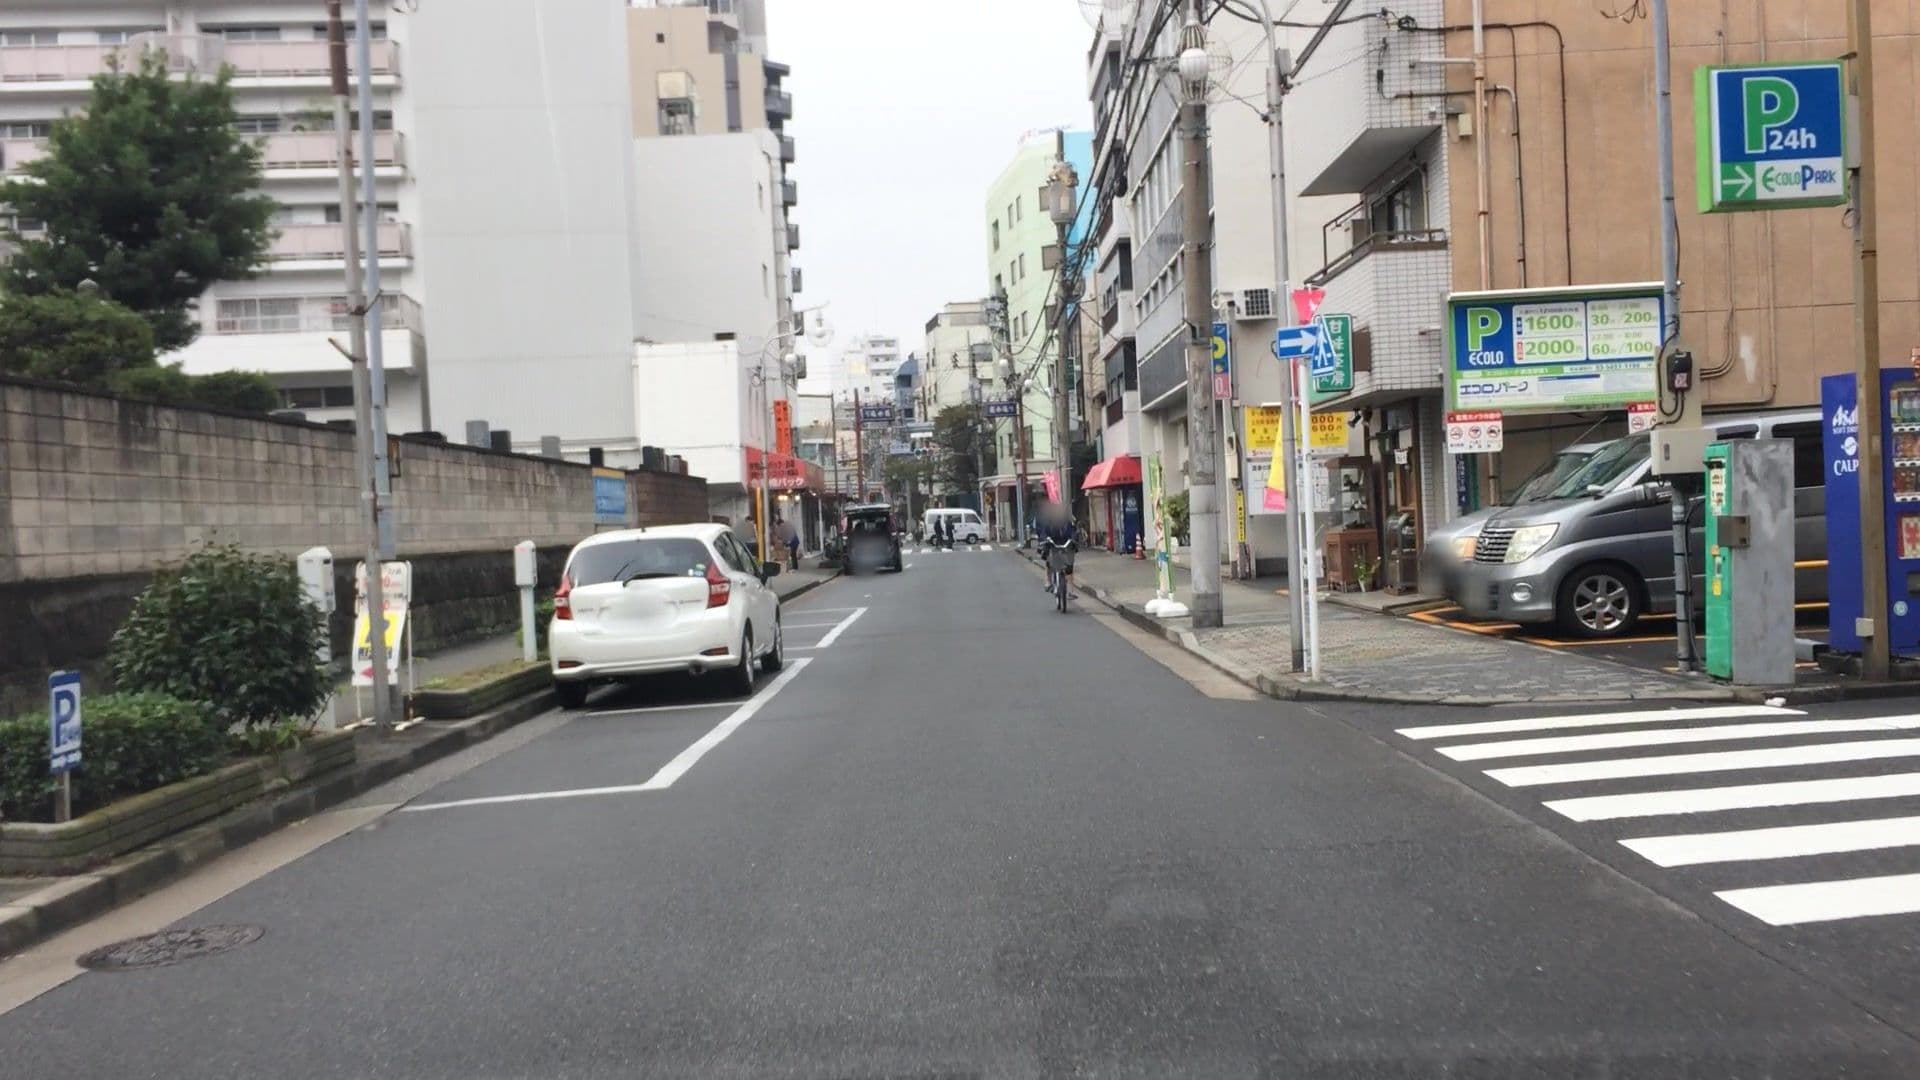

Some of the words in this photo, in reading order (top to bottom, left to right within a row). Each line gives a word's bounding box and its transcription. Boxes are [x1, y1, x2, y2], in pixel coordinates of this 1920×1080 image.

[1742, 76, 1799, 154] P
[1769, 128, 1816, 150] 24h
[1466, 306, 1503, 352] P
[1469, 351, 1504, 366] ECOLO
[1460, 380, 1529, 396] エコロパーク
[55, 690, 75, 748] P
